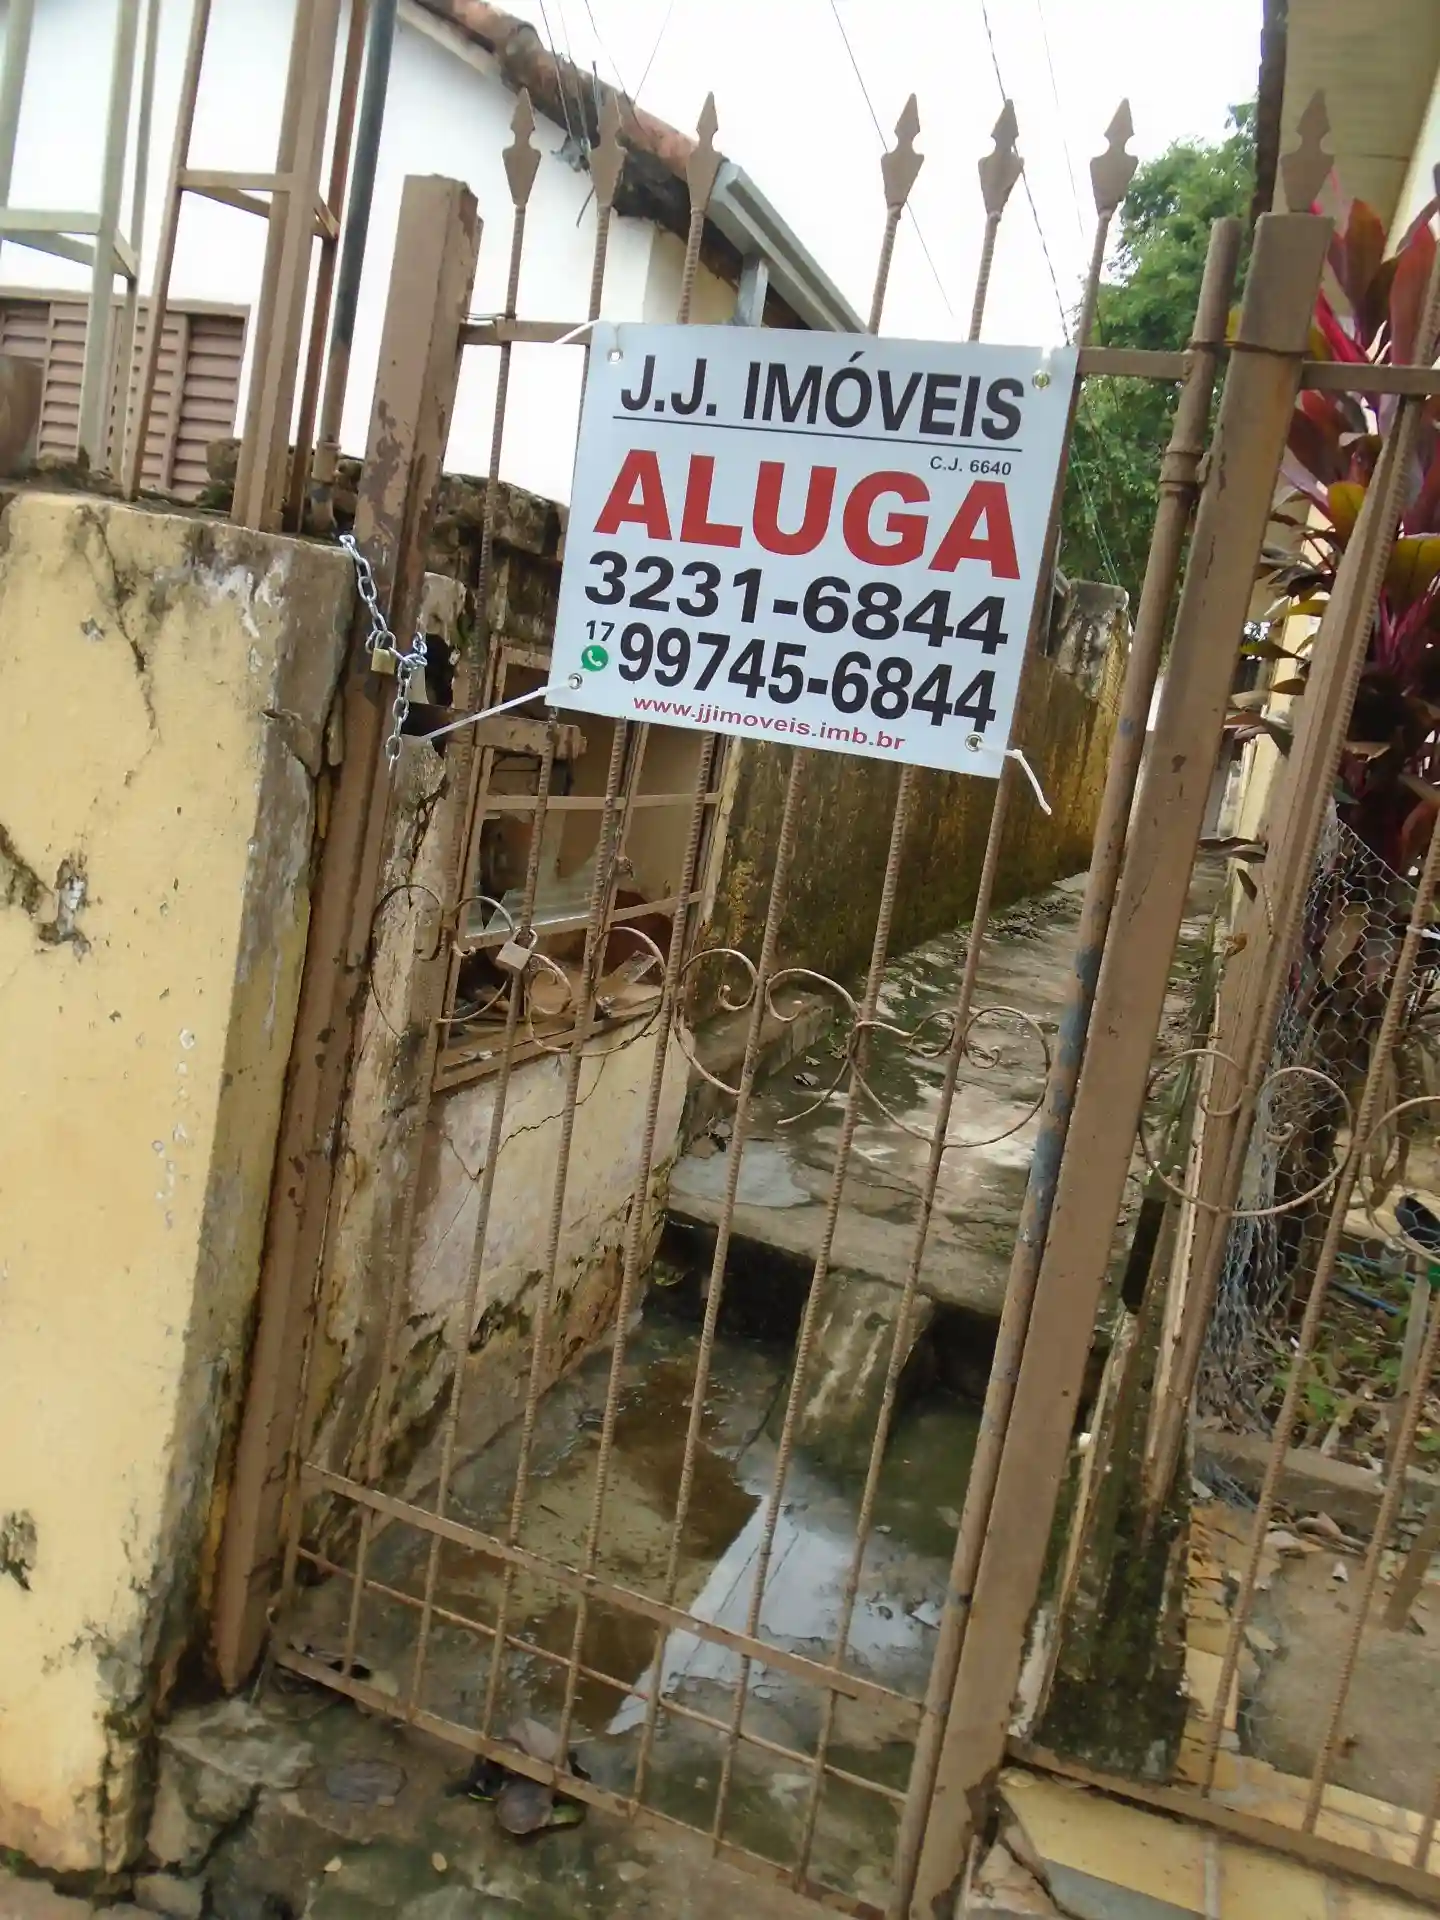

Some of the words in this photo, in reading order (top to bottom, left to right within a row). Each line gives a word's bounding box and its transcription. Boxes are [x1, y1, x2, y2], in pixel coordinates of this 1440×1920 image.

[621, 354, 717, 417] J.J.
[743, 351, 1025, 441] IMÓVEIS
[592, 448, 1021, 580] ALUGA
[929, 456, 963, 473] C.J.
[969, 459, 1012, 476] 6640
[584, 550, 1009, 655] 3231-6844
[585, 620, 615, 643] 17
[618, 622, 997, 733] 99745-6844
[633, 695, 906, 751] www.jjimoveis.imb.br
